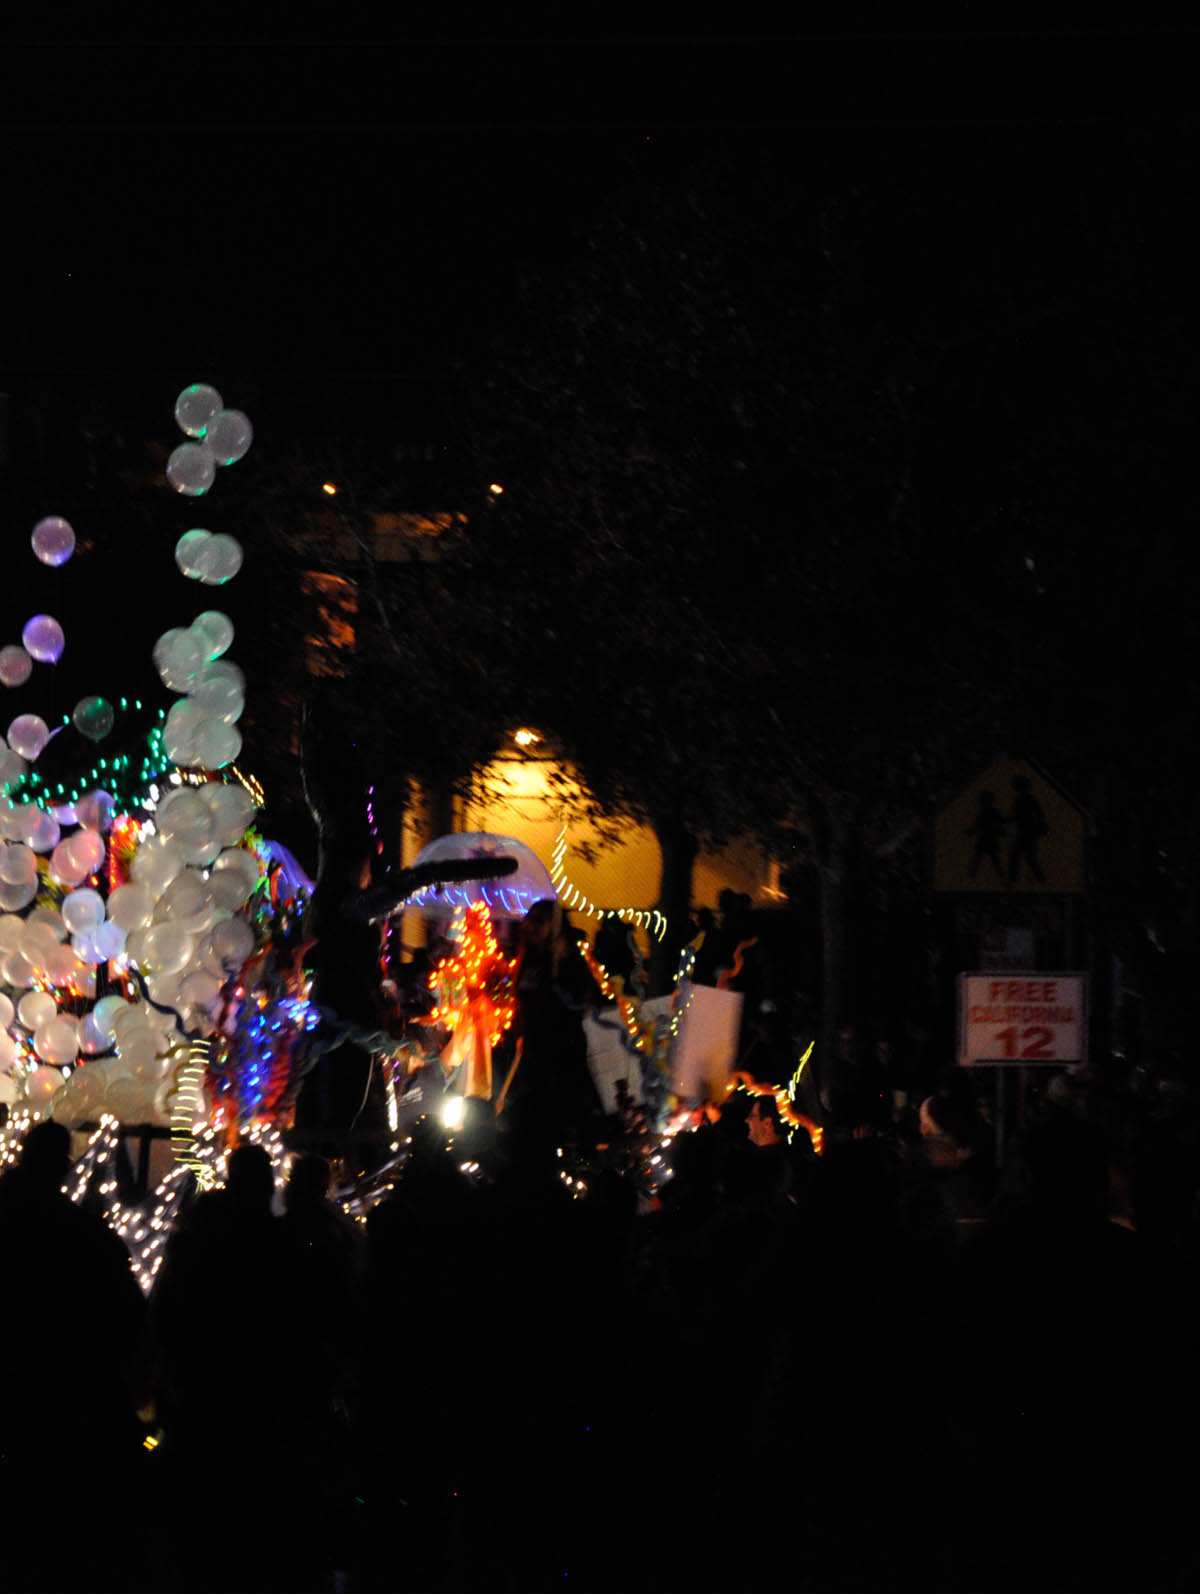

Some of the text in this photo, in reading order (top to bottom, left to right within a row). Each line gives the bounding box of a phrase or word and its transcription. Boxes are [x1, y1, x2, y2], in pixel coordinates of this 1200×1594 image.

[990, 981, 1057, 1003] FREE
[970, 1006, 1076, 1024] CALIFORNIA
[994, 1026, 1057, 1058] 12
